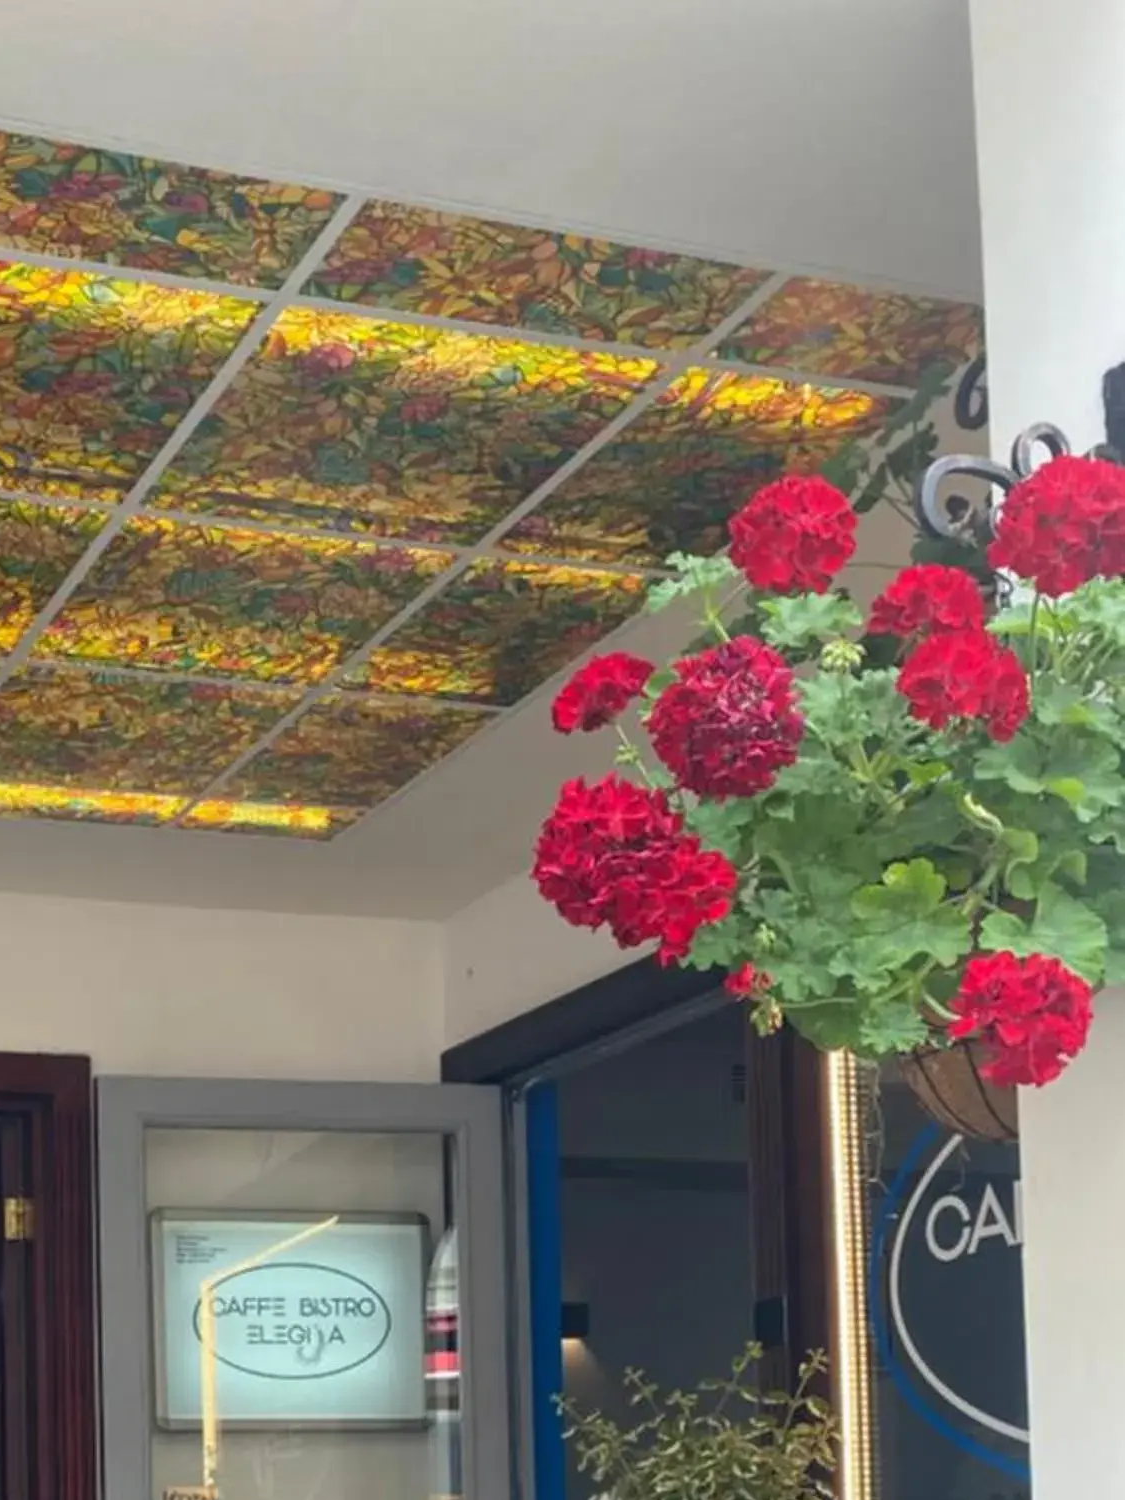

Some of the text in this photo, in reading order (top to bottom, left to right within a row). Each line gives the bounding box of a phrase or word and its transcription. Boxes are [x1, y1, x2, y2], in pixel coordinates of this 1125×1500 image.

[211, 1296, 376, 1319] CAFFE BISTRO
[246, 1324, 346, 1366] ELEGIJA
